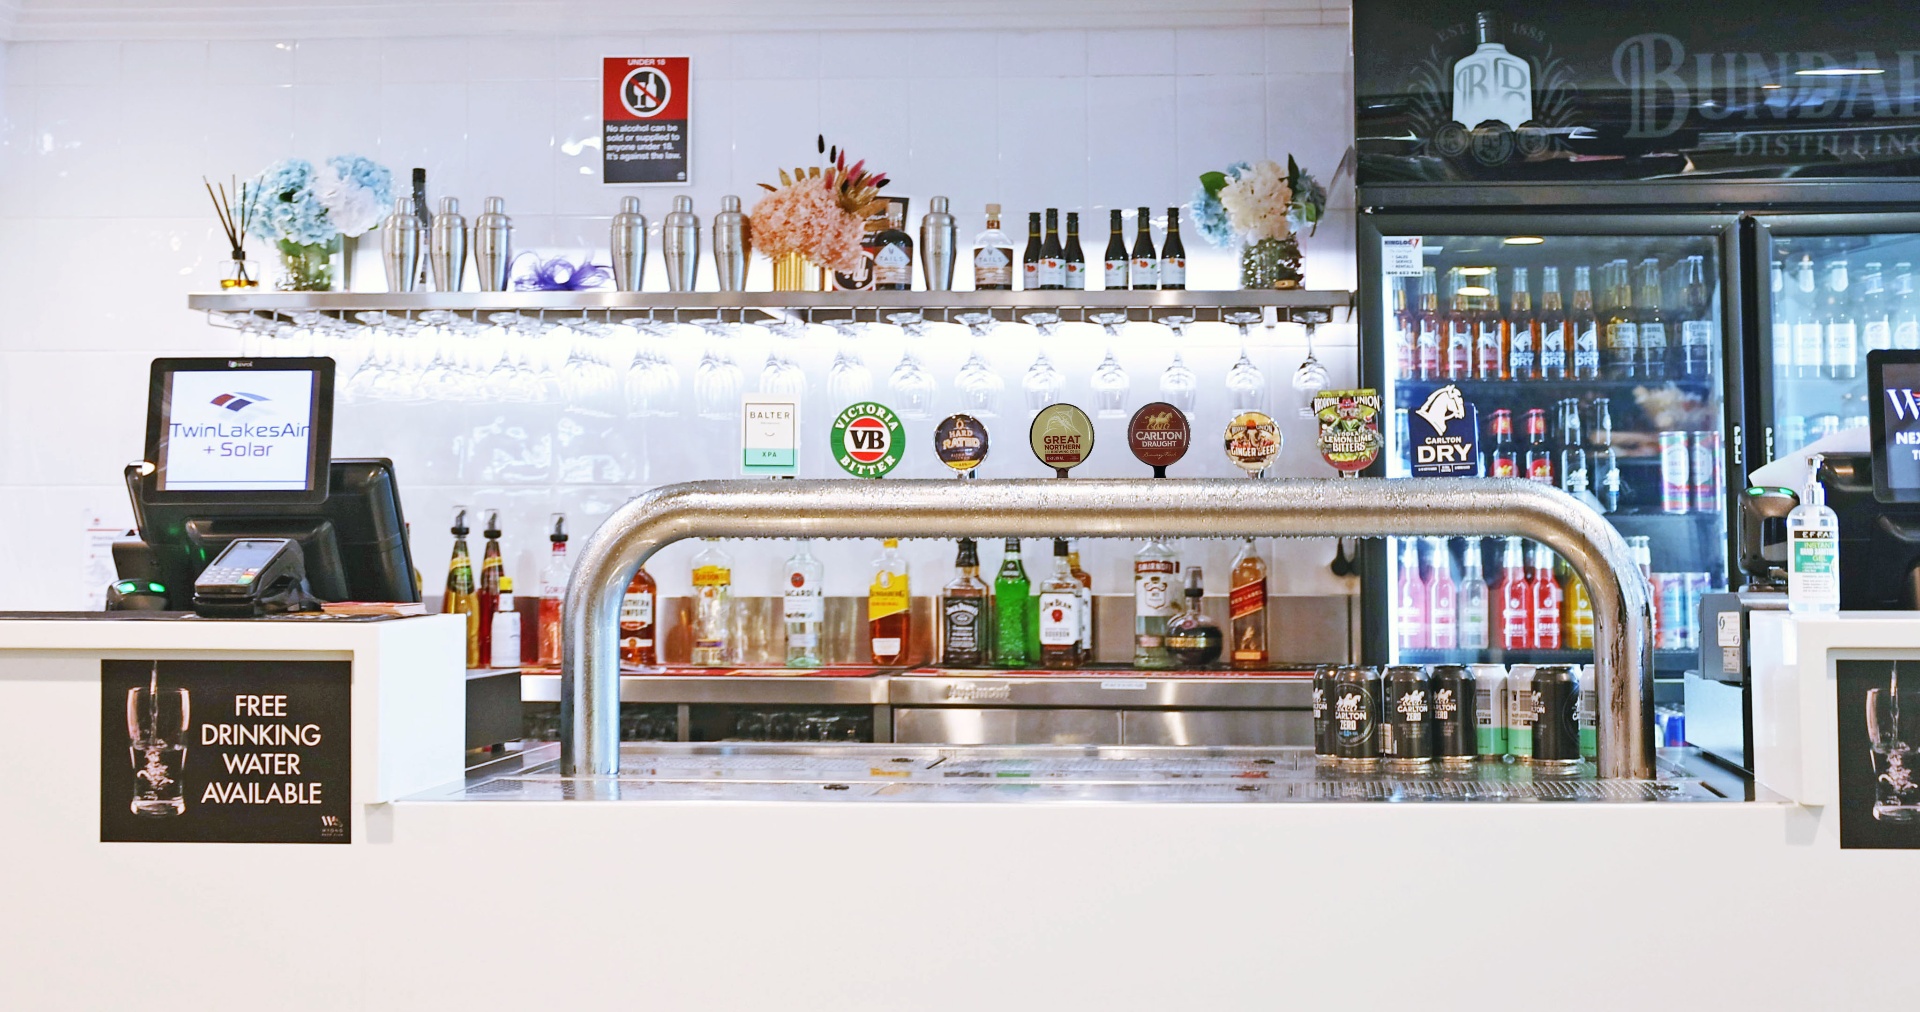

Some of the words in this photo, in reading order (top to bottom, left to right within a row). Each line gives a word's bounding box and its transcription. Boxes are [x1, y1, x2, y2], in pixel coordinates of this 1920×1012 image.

[627, 58, 655, 66] UNDER
[657, 58, 666, 66] 18
[606, 124, 618, 133] No
[619, 124, 649, 133] alcohol
[650, 125, 666, 133] can
[667, 124, 678, 133] be
[606, 133, 625, 142] sold
[636, 133, 670, 144] supplied
[671, 133, 681, 142] to
[606, 144, 636, 153] anyone
[637, 143, 661, 152] under
[663, 143, 674, 151] 18.
[606, 153, 618, 161] It's
[619, 152, 650, 163] against
[651, 152, 664, 160] the
[665, 152, 681, 160] law.
[1510, 357, 1535, 367] DRY
[1541, 357, 1566, 367] DRY
[1574, 357, 1599, 367] DRY
[1353, 395, 1381, 412] UNION
[750, 411, 791, 420] BALTER
[834, 403, 900, 433] VICTORIA
[949, 429, 974, 438] HARD
[1135, 431, 1183, 441] CARLTON
[1324, 434, 1352, 443] LEMON
[1354, 433, 1373, 443] LIME
[849, 429, 885, 450] VB
[942, 437, 981, 450] RATED
[1043, 435, 1082, 444] GREAT
[1141, 440, 1177, 448] DRAUGHT
[1425, 436, 1462, 445] CARLTON
[220, 442, 273, 458] Solar
[1332, 442, 1366, 452] BITTERS
[1733, 425, 1742, 465] PULL
[1230, 446, 1257, 457] GINGER
[1417, 443, 1472, 464] DRY
[839, 454, 897, 476] BITTER
[1243, 589, 1263, 601] LABEL
[1042, 600, 1053, 612] JIM
[1055, 598, 1072, 610] BEAM
[235, 694, 288, 717] FREE
[1397, 705, 1428, 713] CARLTON
[1335, 711, 1367, 721] CARLTON
[1406, 712, 1422, 722] ZERO
[1435, 711, 1448, 720] ZERO
[1340, 720, 1357, 731] ZERO
[201, 723, 322, 747] DRINKING
[222, 752, 301, 775] WATER
[200, 782, 323, 804] AVAILABLE
